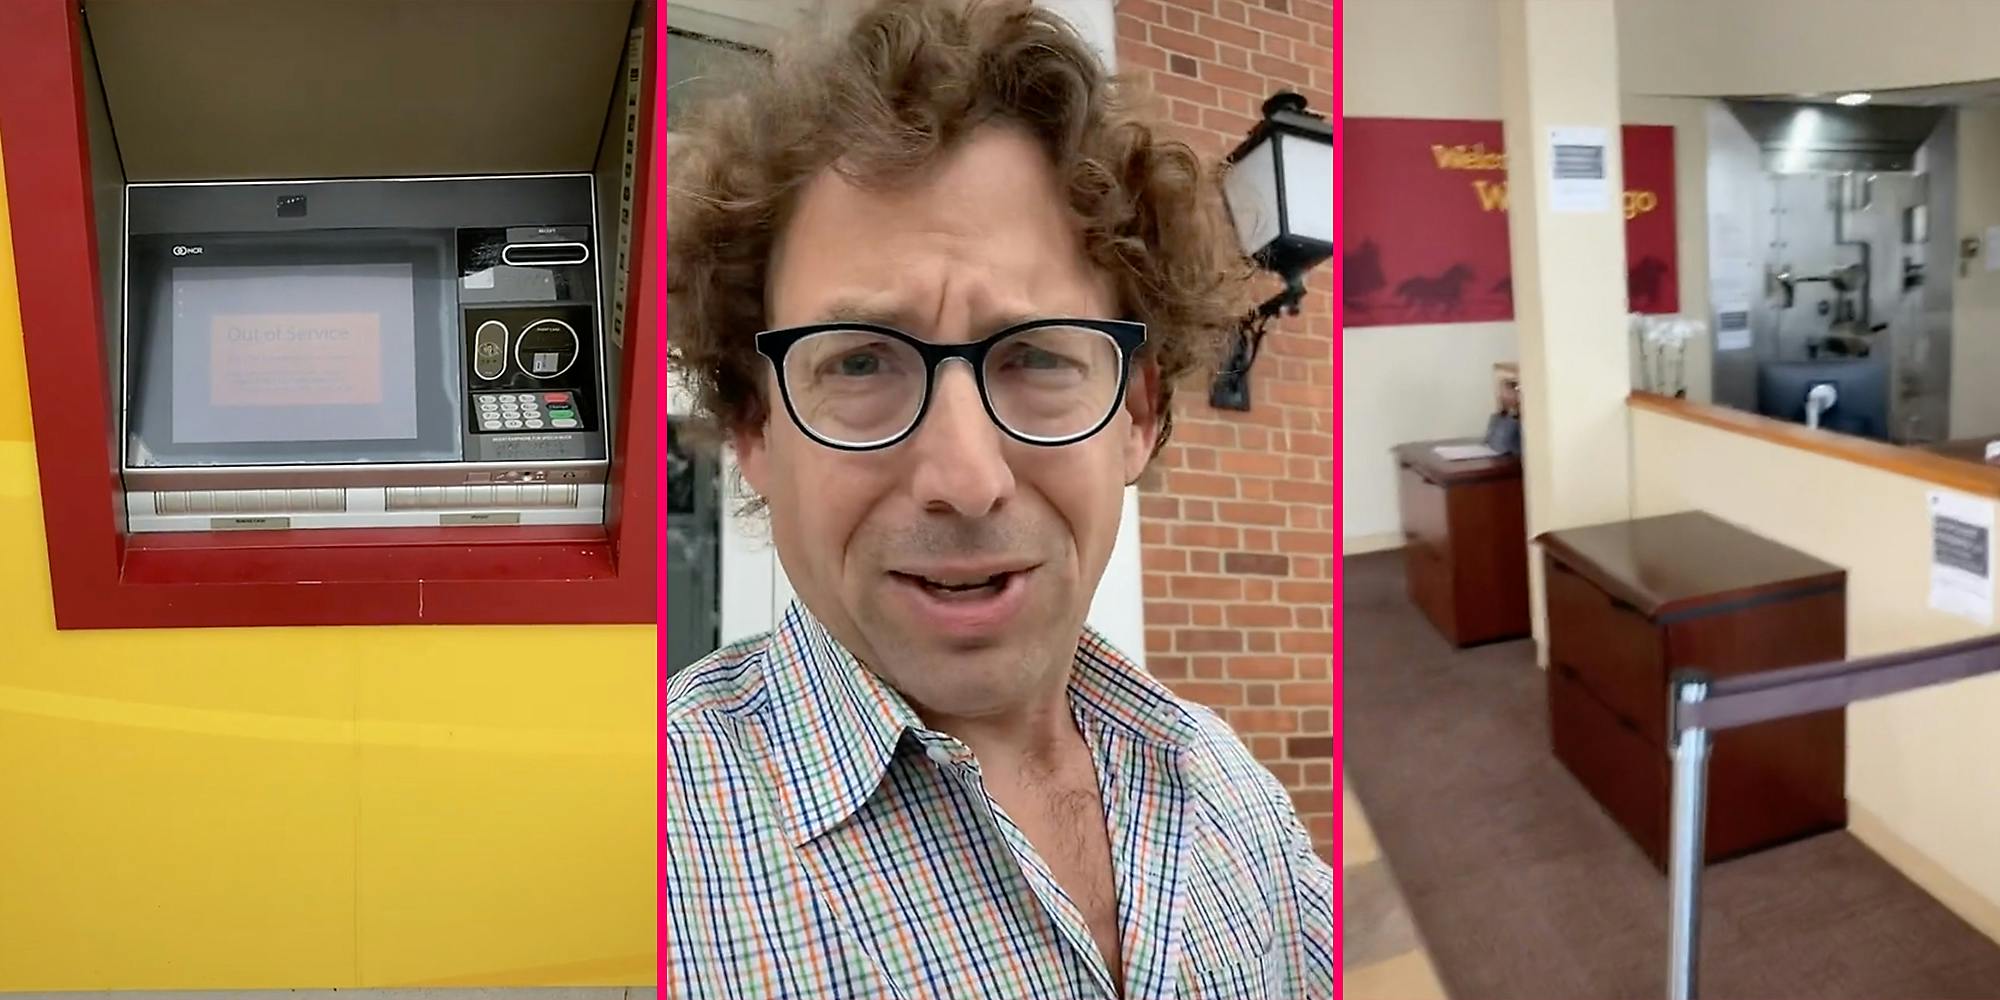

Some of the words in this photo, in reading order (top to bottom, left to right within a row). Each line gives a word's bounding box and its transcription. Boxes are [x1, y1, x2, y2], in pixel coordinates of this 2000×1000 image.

[1623, 191, 1657, 220] go
[187, 247, 204, 255] NCR
[227, 327, 258, 342] Out
[264, 326, 283, 342] of
[287, 325, 350, 341] Service
